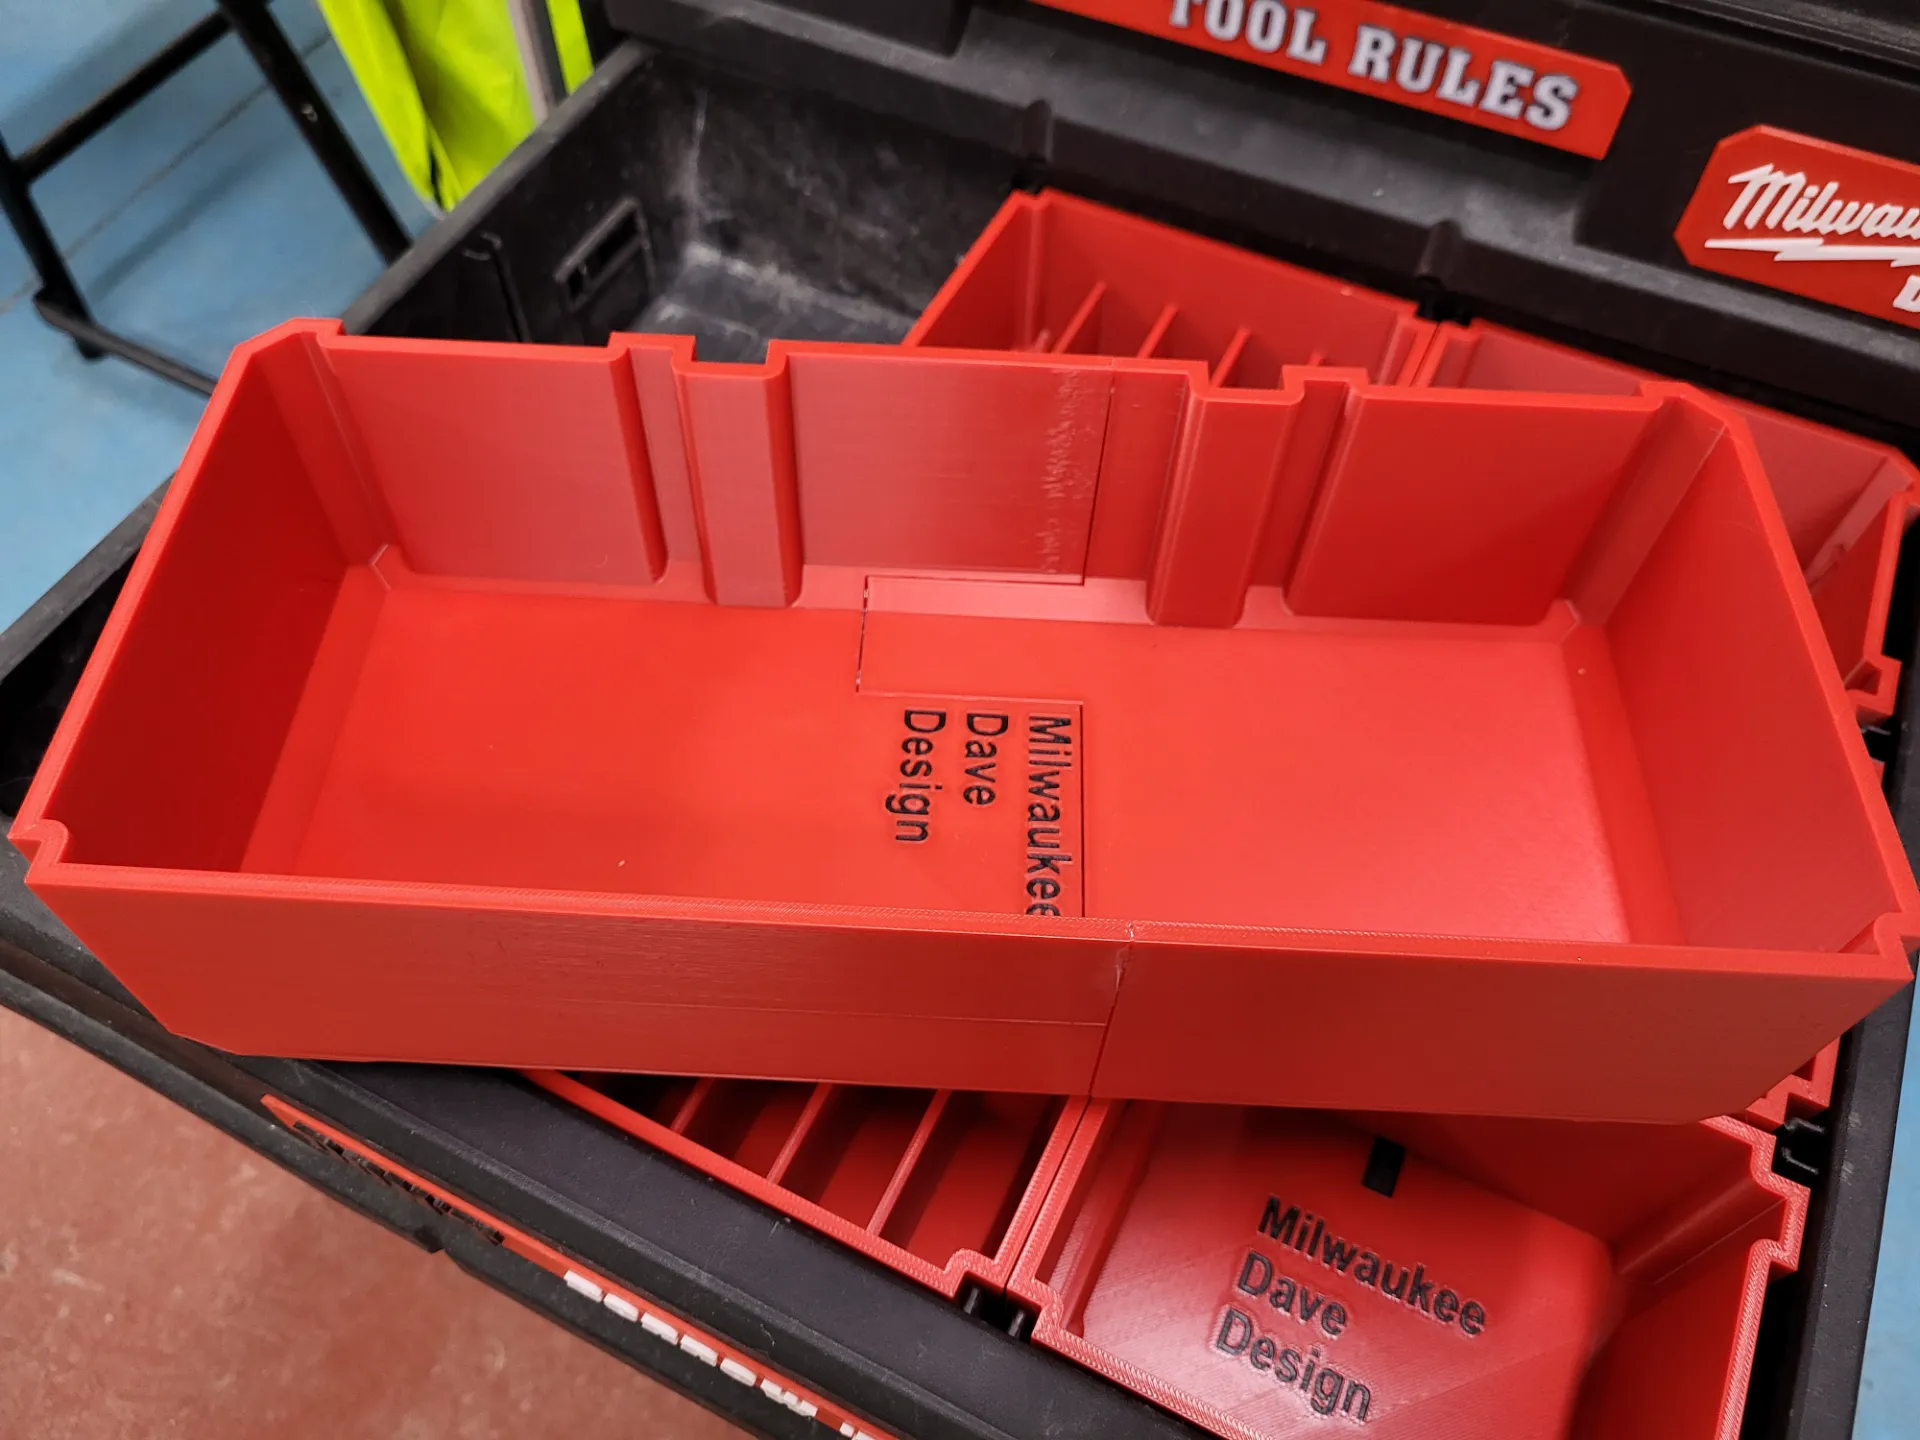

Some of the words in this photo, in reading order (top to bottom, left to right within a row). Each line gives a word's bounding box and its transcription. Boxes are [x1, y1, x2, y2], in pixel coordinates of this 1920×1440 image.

[1347, 23, 1579, 131] RULES
[885, 709, 947, 842] Design
[963, 712, 1009, 806] Dave
[1236, 1250, 1348, 1338] Dave
[1257, 1195, 1486, 1336] Milwaukee
[1215, 1307, 1372, 1423] Design
